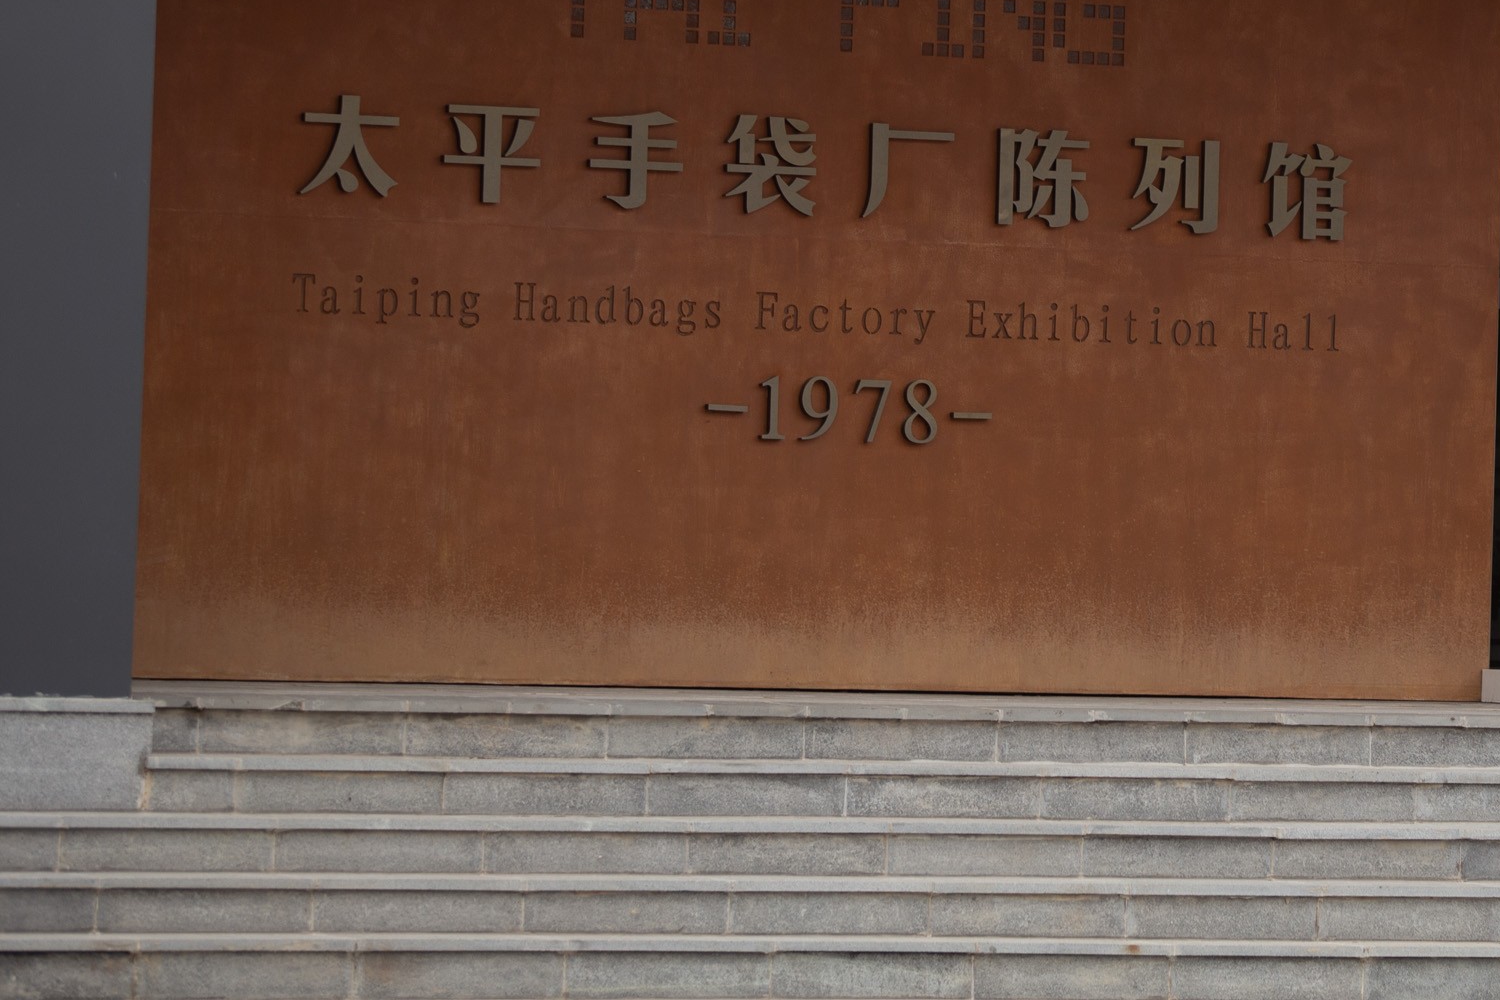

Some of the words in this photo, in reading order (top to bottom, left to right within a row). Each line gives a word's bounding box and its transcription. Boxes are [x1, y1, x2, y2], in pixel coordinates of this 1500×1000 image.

[300, 94, 1354, 242] 太平手袋厂陈列馆
[291, 272, 481, 329] Taiping
[512, 281, 722, 337] Handbags
[754, 291, 936, 345] Factory
[964, 299, 1219, 348] Exhibition
[1246, 311, 1341, 352] Hall
